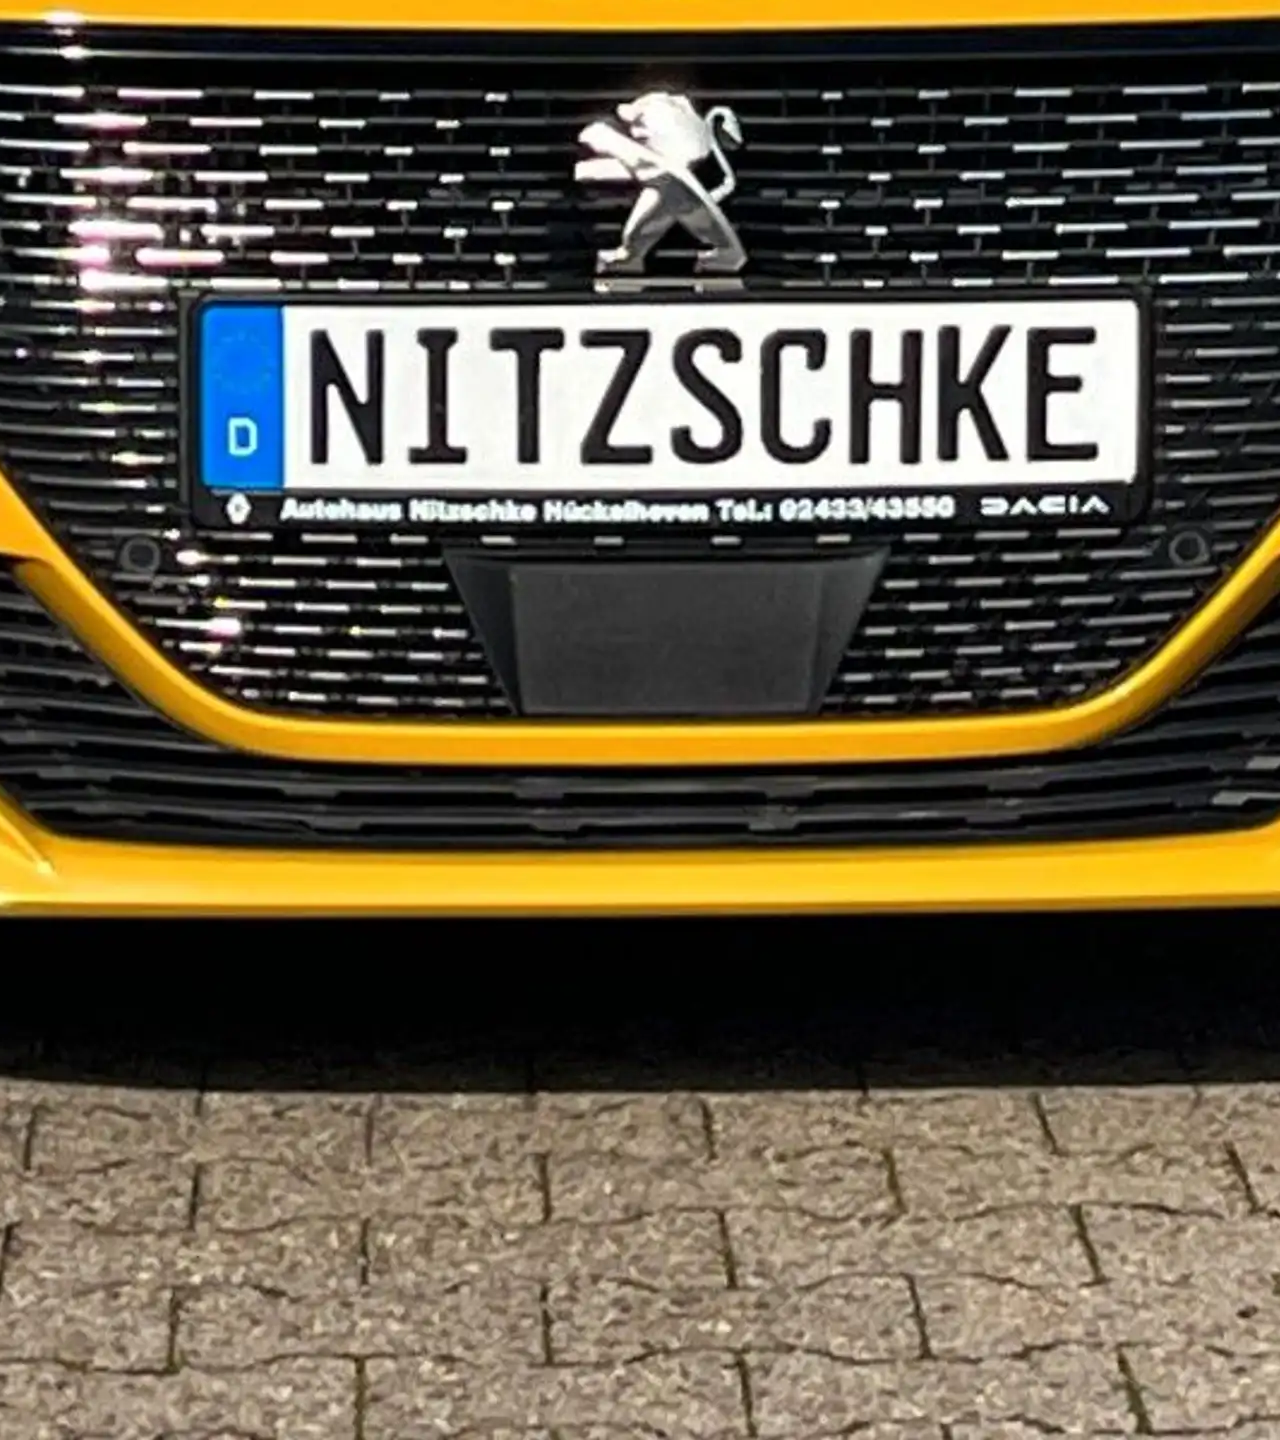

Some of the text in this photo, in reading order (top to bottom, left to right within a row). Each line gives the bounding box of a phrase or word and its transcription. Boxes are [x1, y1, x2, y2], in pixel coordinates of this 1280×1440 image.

[310, 326, 1098, 464] NITZSCHKE
[228, 418, 257, 455] D
[280, 498, 403, 521] Autohaus
[409, 498, 537, 522] Nitzschke
[542, 499, 710, 523] Hückelhoven
[980, 496, 1110, 516] DACIA
